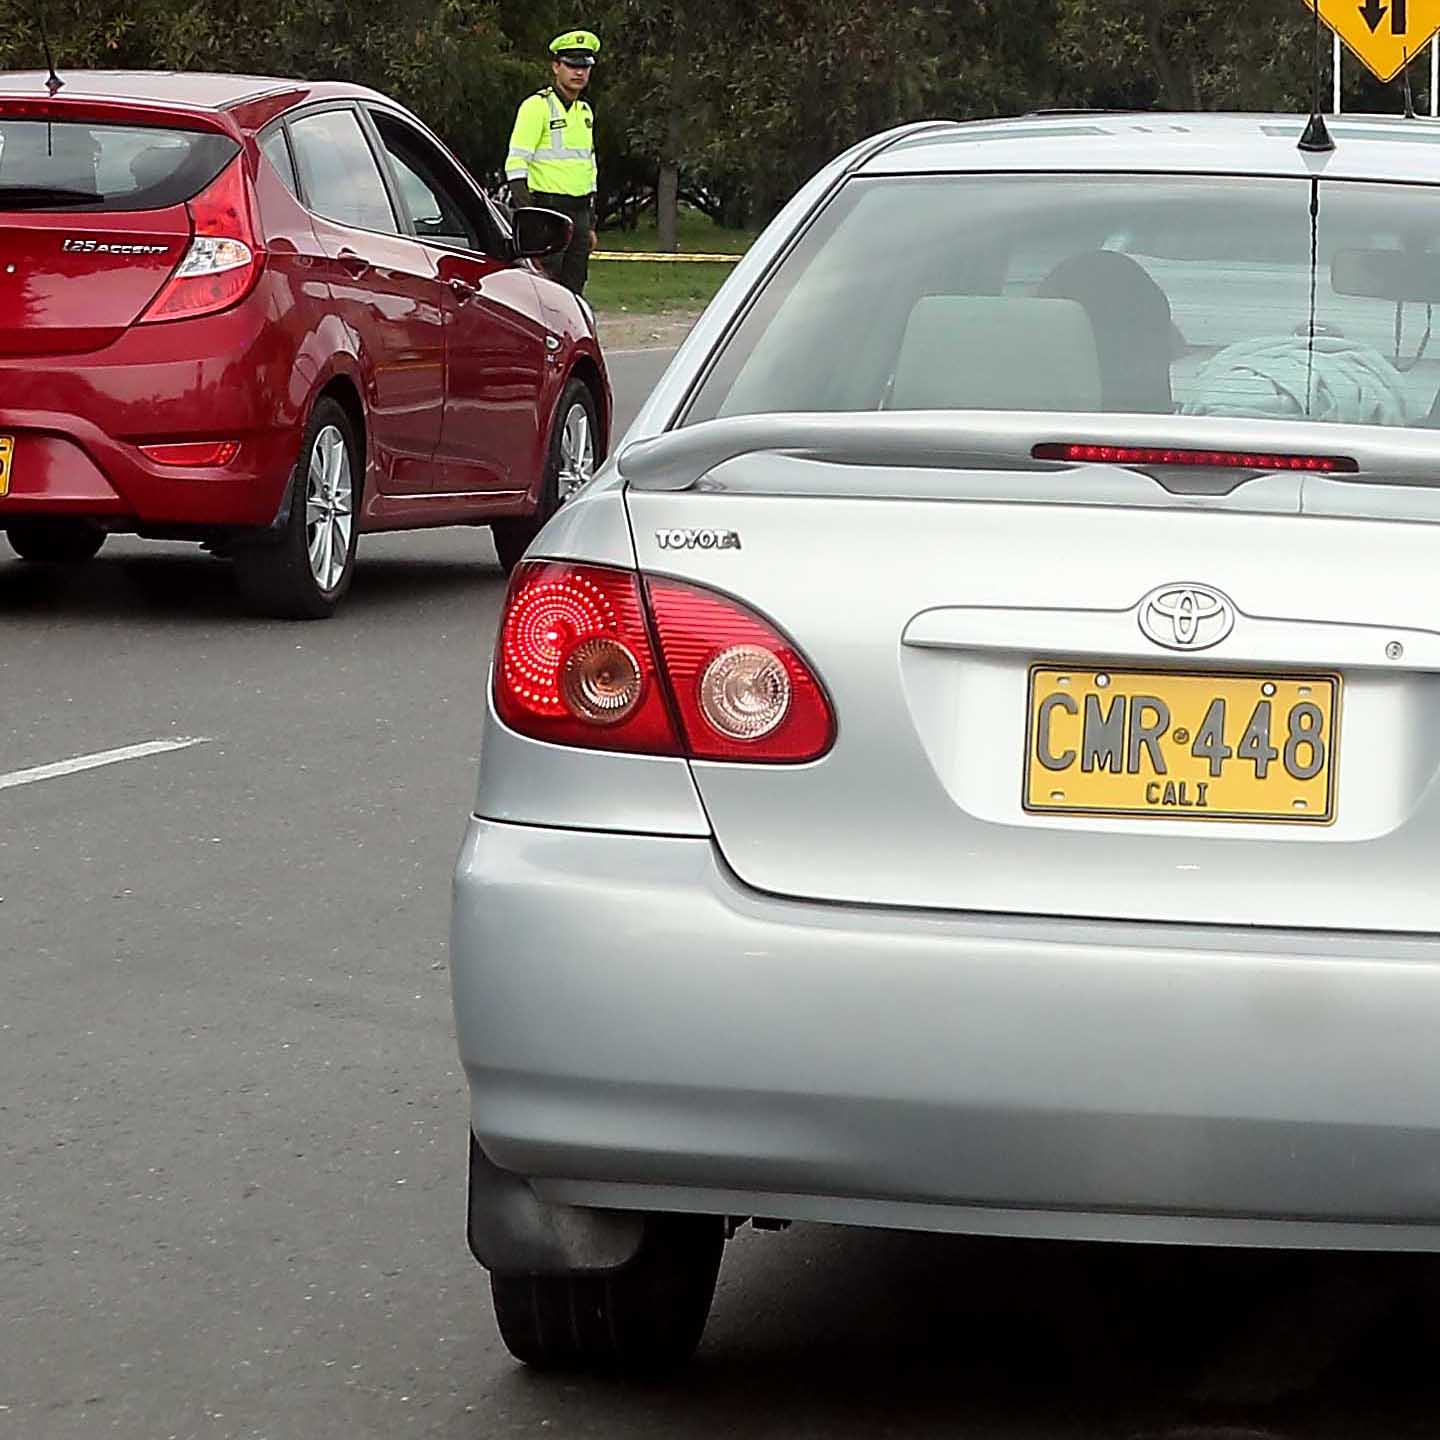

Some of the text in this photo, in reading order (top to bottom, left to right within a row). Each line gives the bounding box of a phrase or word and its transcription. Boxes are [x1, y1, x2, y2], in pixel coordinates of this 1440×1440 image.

[96, 244, 169, 254] ACCENT
[655, 528, 742, 550] TOYOTA
[1145, 781, 1209, 807] CALI
